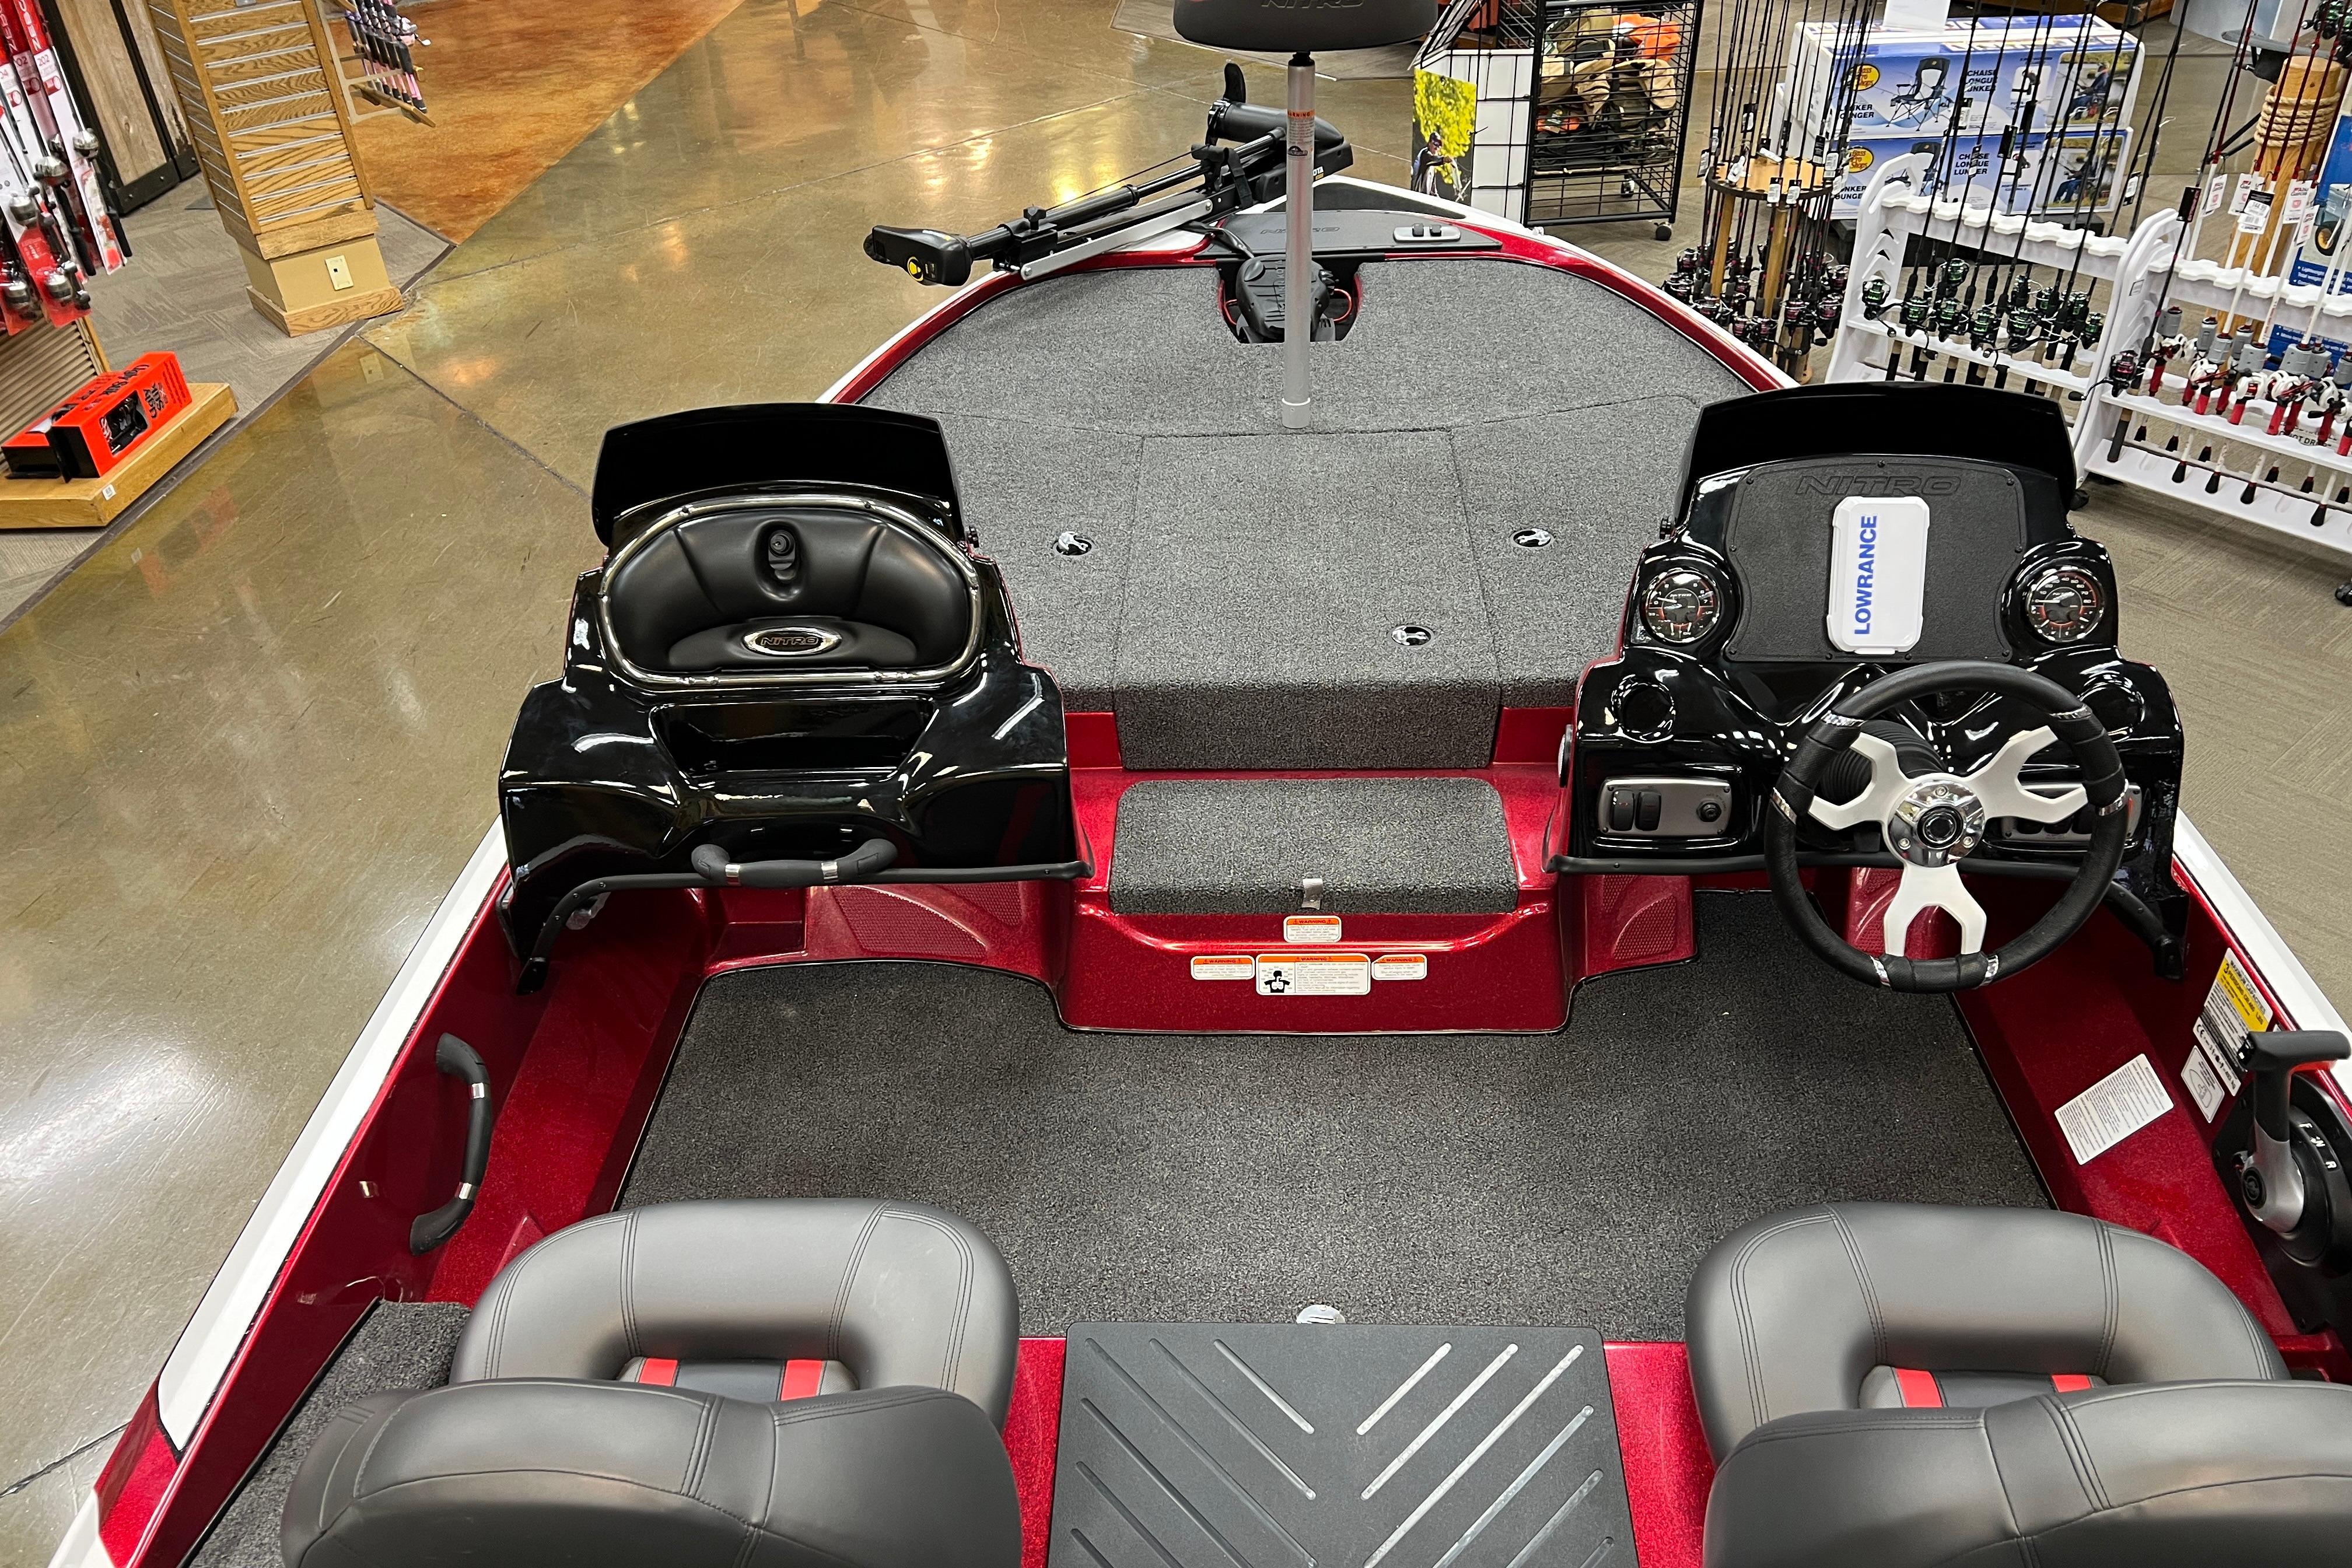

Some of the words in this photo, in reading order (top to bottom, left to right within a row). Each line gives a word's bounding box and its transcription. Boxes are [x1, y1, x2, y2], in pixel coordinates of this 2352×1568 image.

[16, 56, 28, 66] 02
[1313, 166, 1324, 176] OTA
[1796, 475, 1961, 495] NITRO
[1854, 515, 1878, 635] LOWRANCE
[761, 636, 819, 646] NITRO
[2223, 963, 2230, 974] 3
[2325, 1161, 2337, 1169] R
